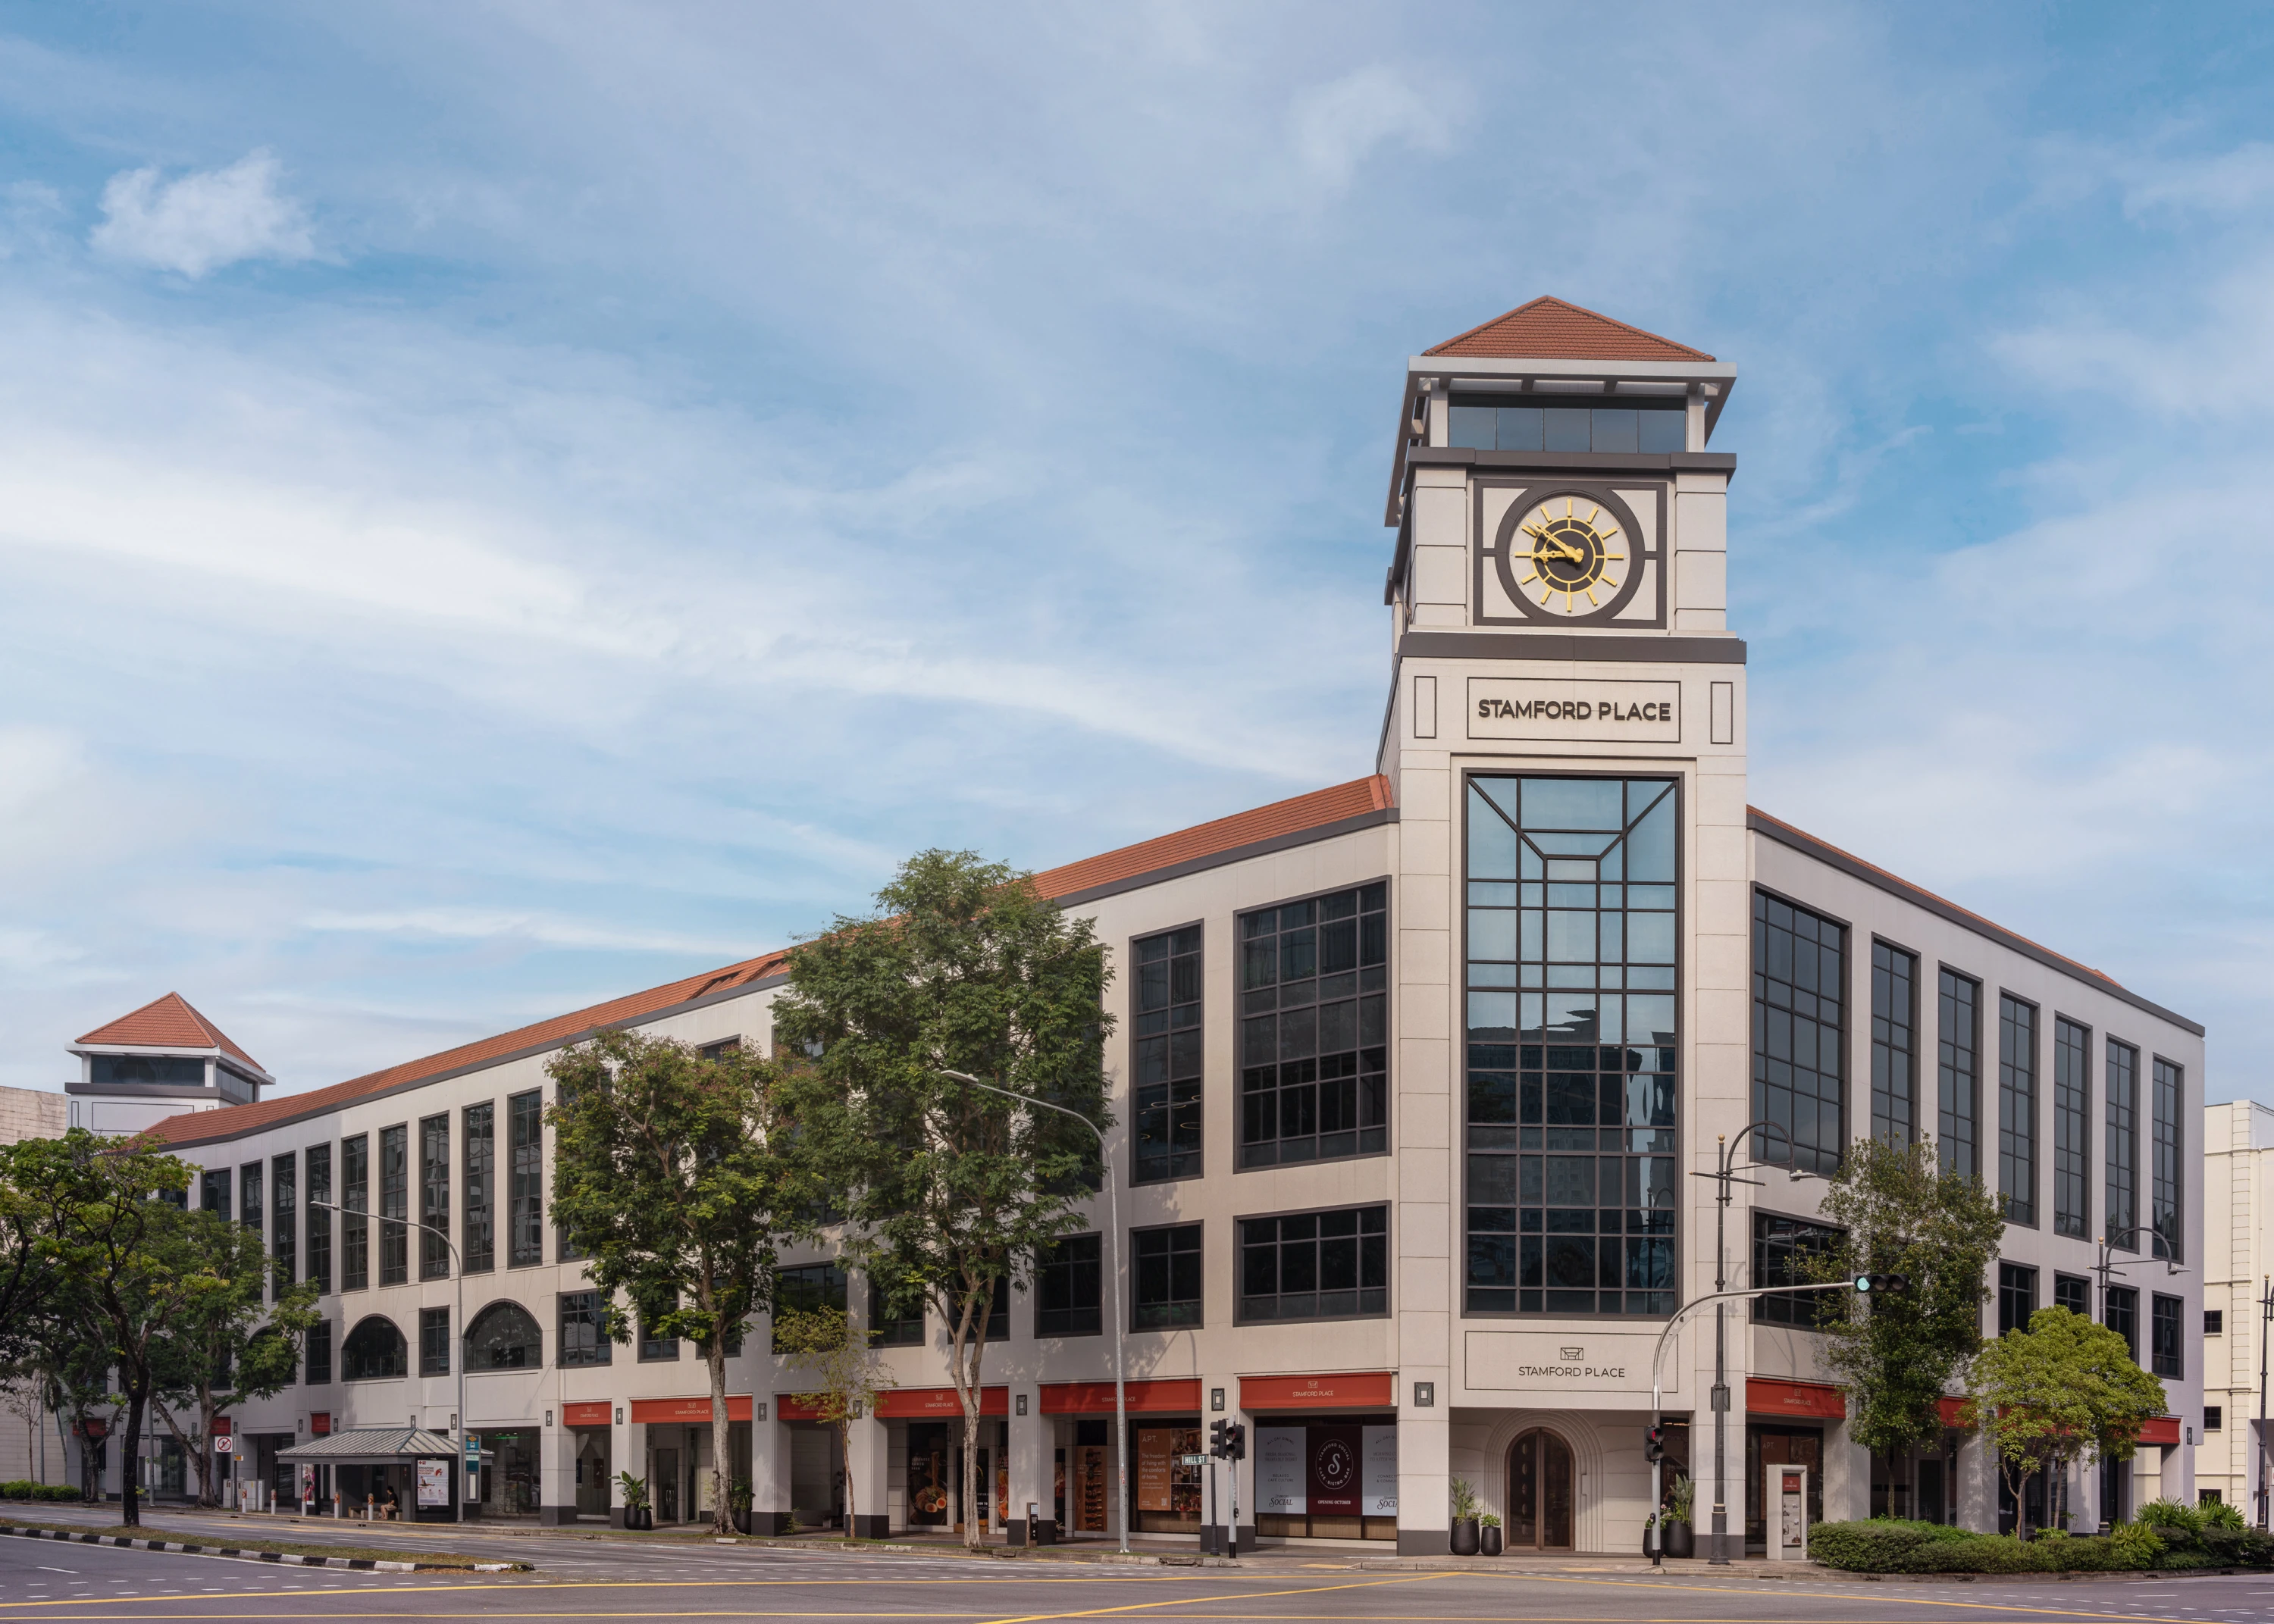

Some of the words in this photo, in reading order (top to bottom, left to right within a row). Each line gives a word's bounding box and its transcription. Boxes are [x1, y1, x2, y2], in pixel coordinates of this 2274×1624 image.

[1478, 699, 1592, 720] STAMFORD
[1599, 702, 1671, 721] PLACE
[1518, 1366, 1582, 1377] STAMFORD
[1585, 1367, 1625, 1378] PLACE
[1319, 1443, 1337, 1461] STAMFORD
[1338, 1444, 1350, 1461] SOCIAL
[1185, 1456, 1197, 1464] HILL
[1328, 1453, 1340, 1475] S
[1268, 1497, 1293, 1508] SOCIAL
